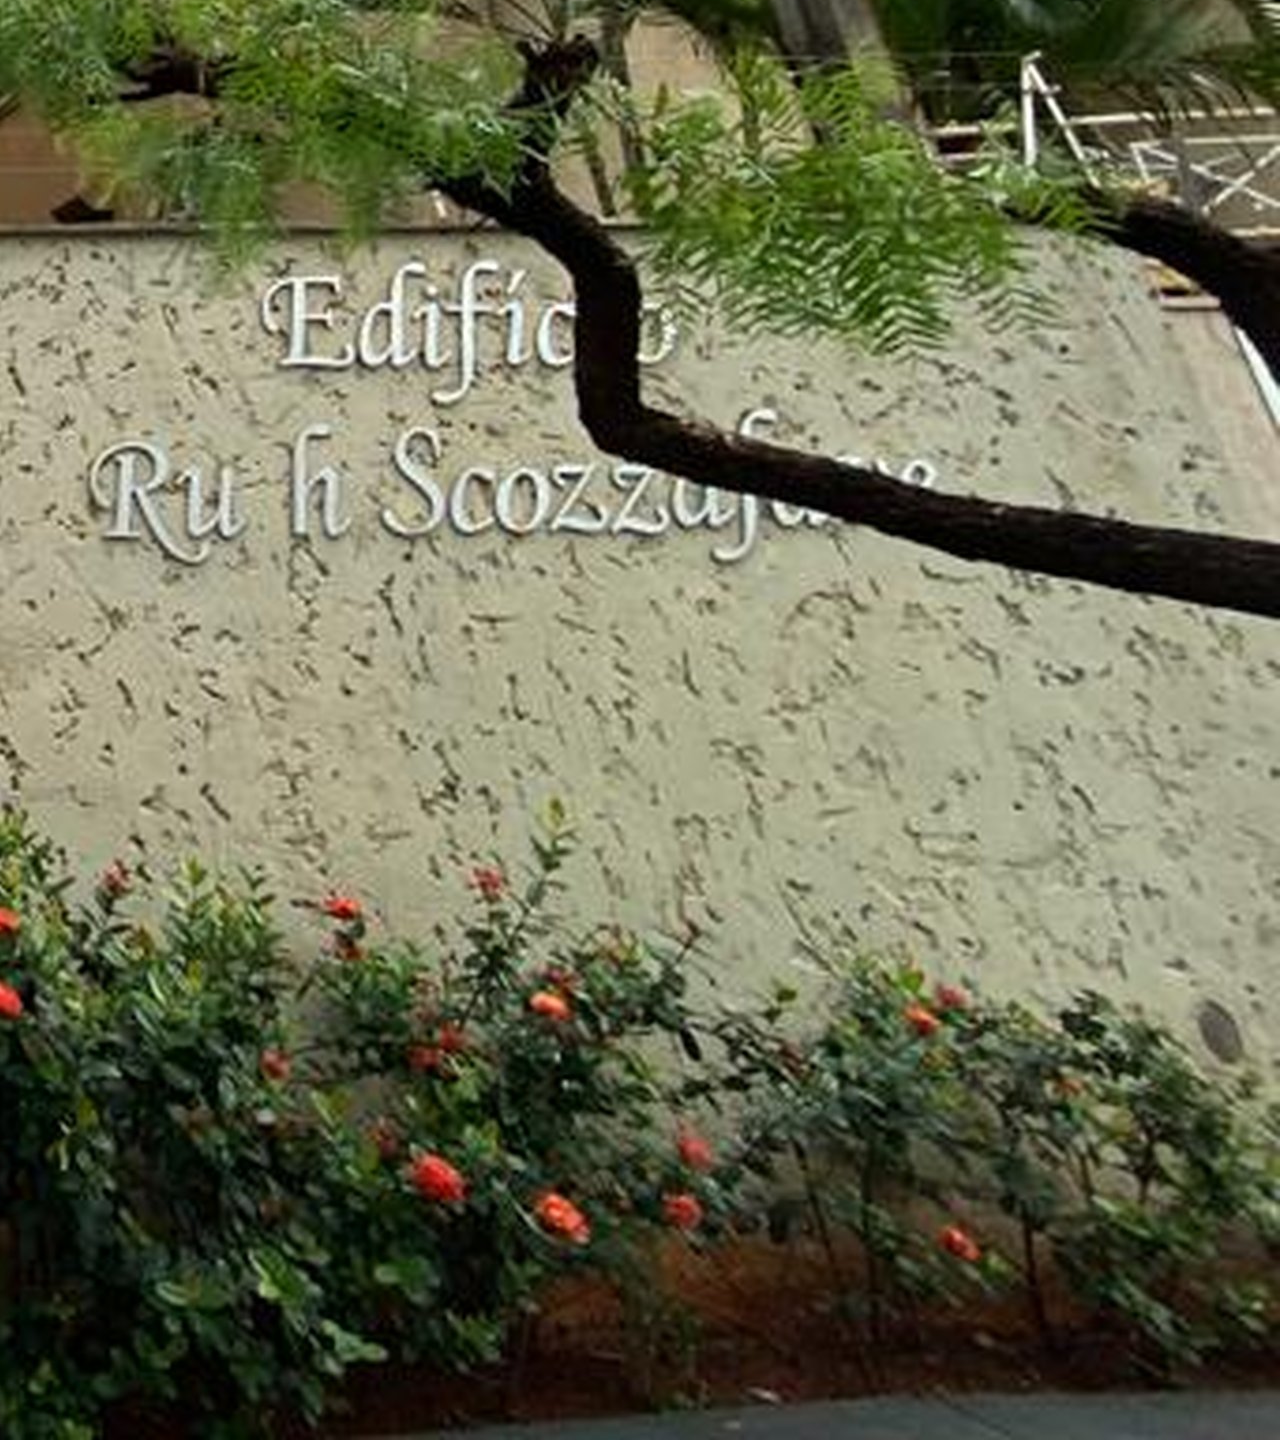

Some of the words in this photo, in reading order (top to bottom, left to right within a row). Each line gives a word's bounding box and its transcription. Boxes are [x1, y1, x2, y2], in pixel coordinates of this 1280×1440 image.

[262, 261, 679, 402] Edifíco
[90, 423, 352, 565] Ruh
[381, 408, 937, 562] Scozzaf
